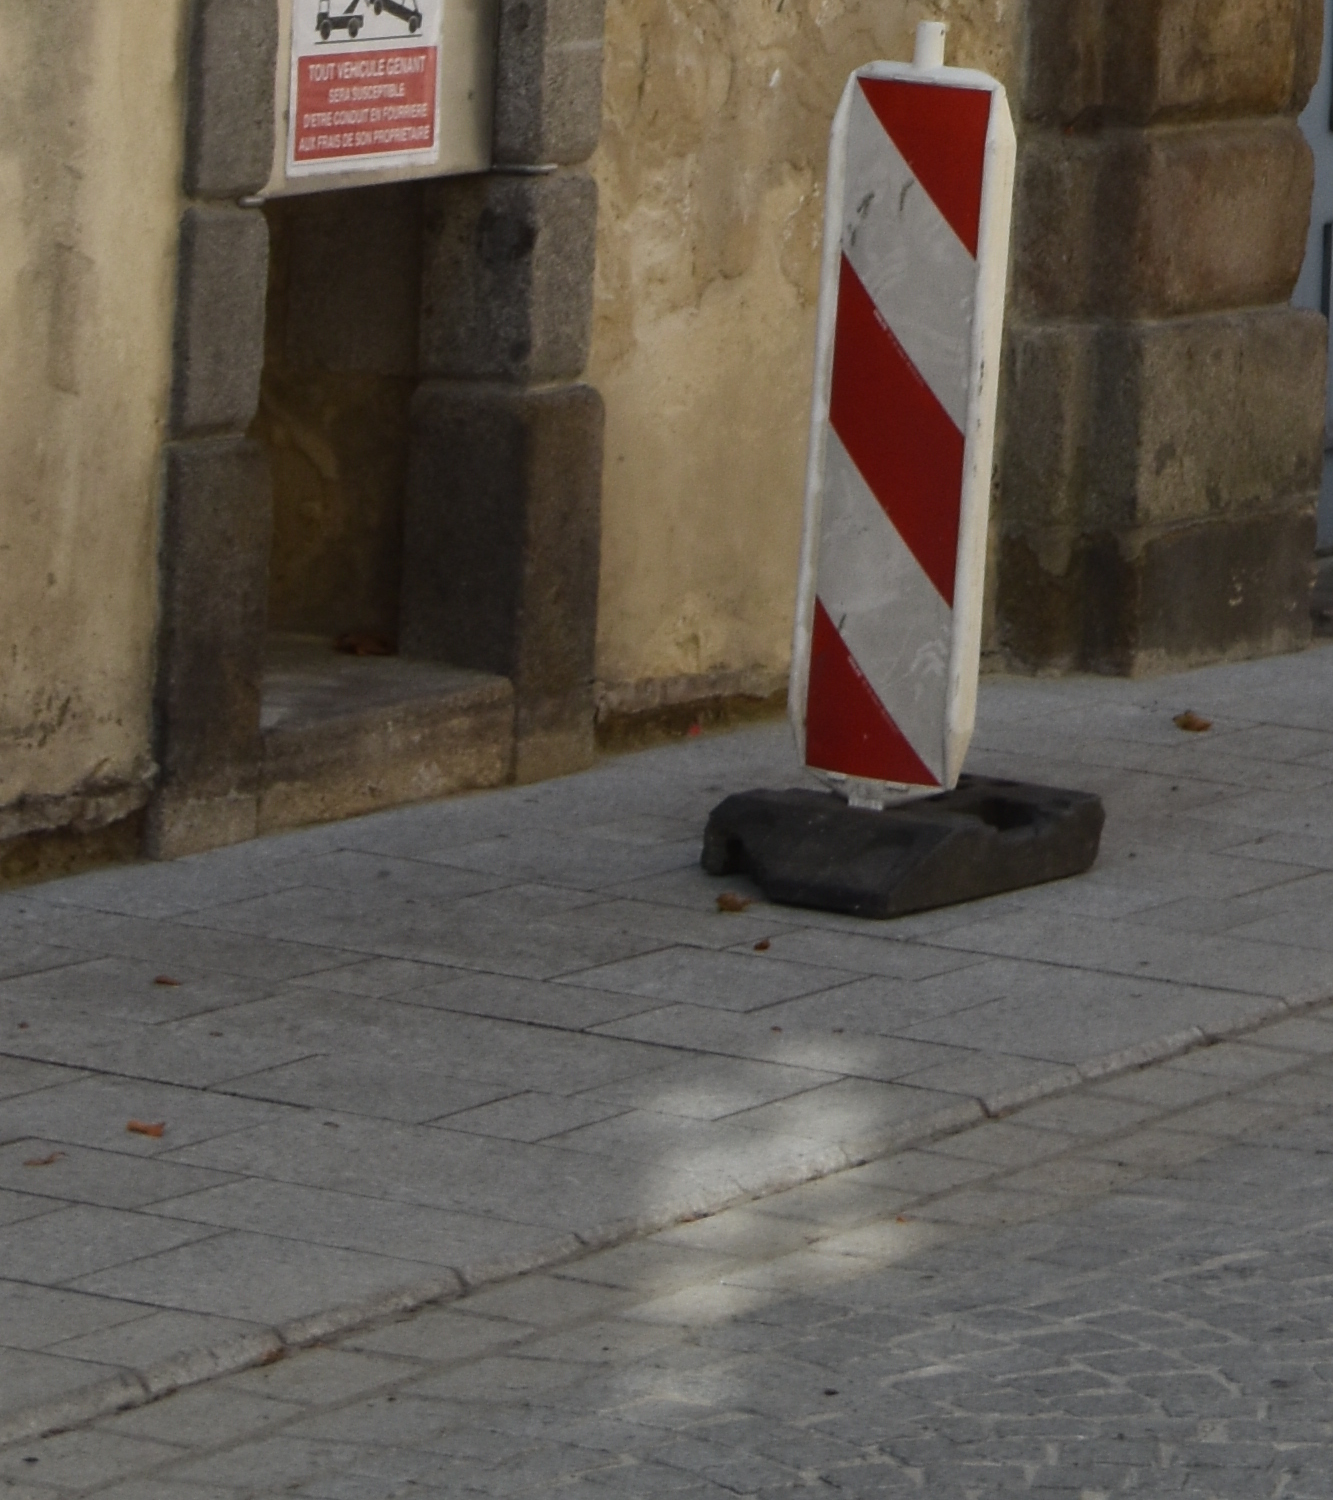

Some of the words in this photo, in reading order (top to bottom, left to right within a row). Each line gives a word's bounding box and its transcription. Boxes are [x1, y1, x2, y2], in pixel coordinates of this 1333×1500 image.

[308, 63, 335, 81] TOUT
[337, 58, 385, 80] VEHICULE
[386, 55, 427, 76] GENANT
[328, 87, 350, 103] SERA
[351, 83, 405, 100] SUSCEPTIBLE
[333, 108, 369, 125] CONDUIT
[370, 107, 381, 122] EN
[382, 103, 428, 120] FOURRIERE
[298, 136, 316, 151] AUX
[317, 134, 341, 149] FRAIS
[342, 133, 354, 147] DE
[355, 131, 372, 146] SON
[373, 125, 430, 145] PROPRIETAIRE
